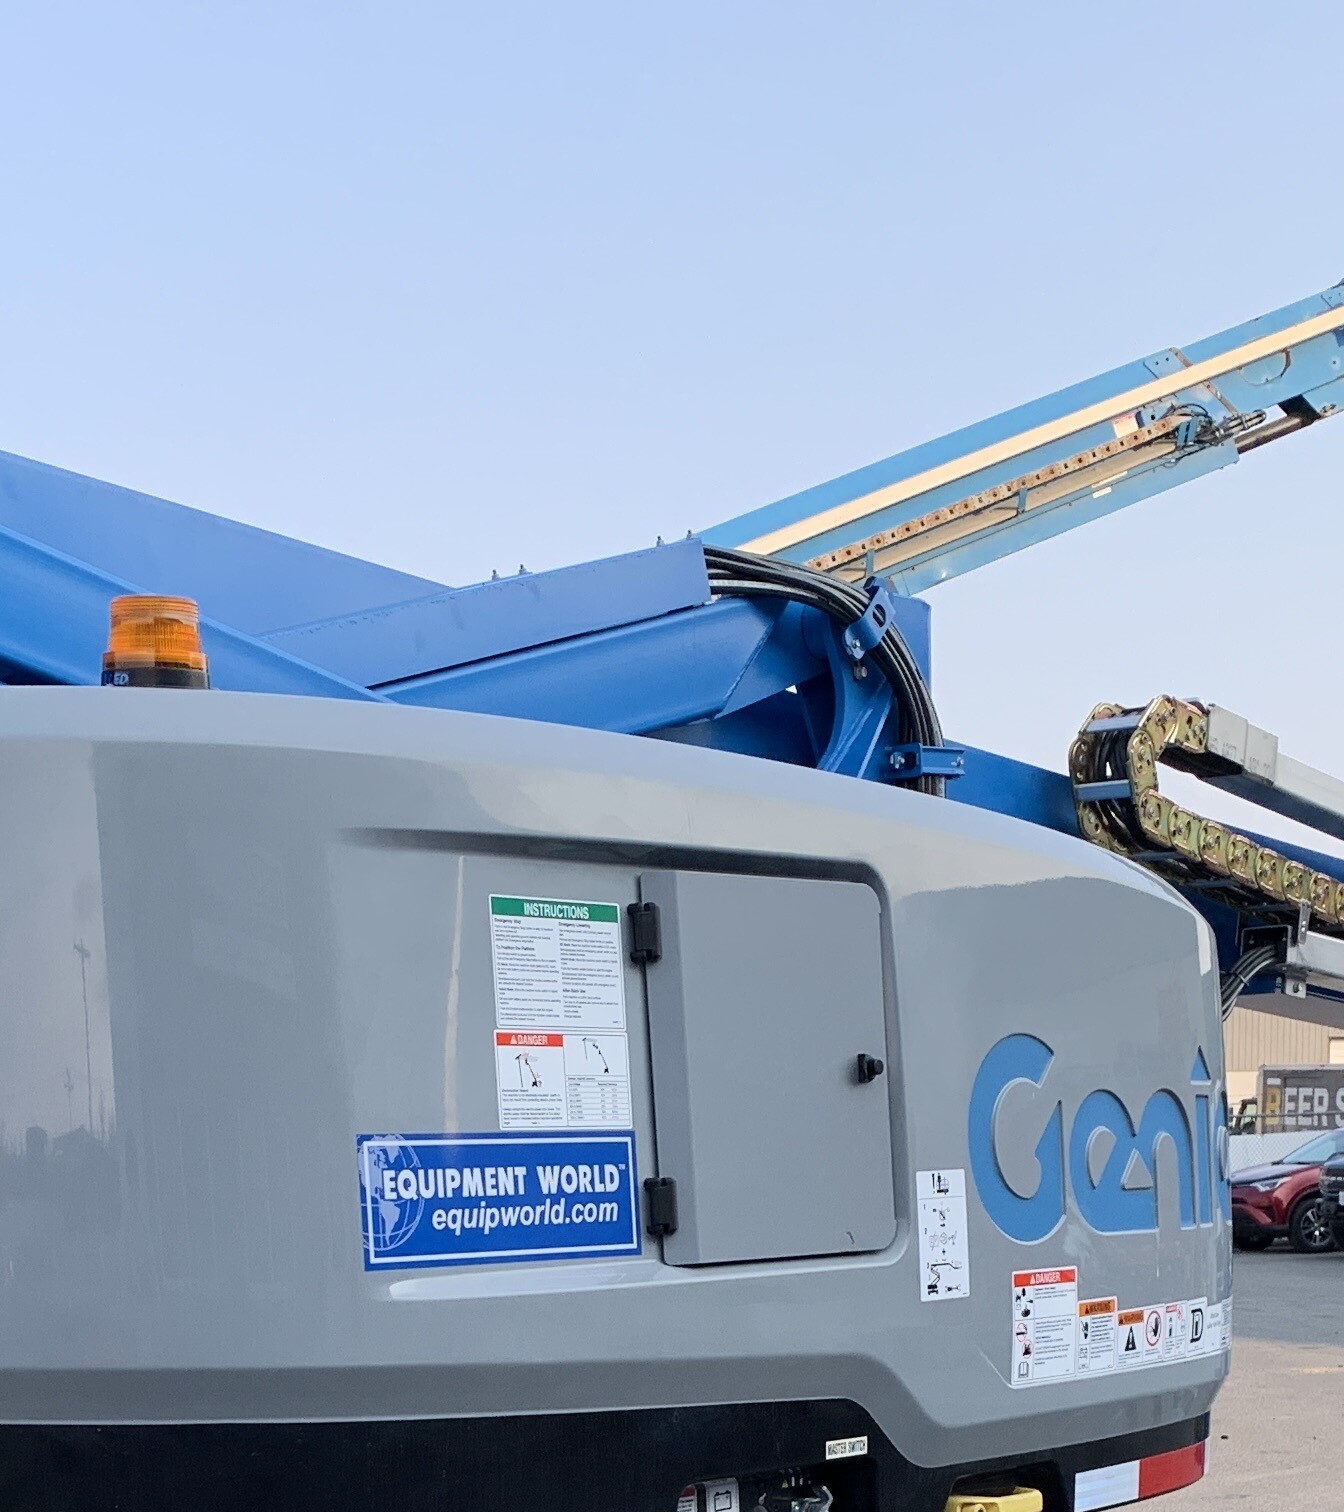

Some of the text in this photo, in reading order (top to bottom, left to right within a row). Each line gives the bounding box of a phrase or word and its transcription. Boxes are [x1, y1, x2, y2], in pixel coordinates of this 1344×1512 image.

[523, 902, 589, 919] INSTRUCTIONS
[517, 1035, 548, 1045] DANGER
[1265, 1087, 1329, 1127] BEER
[382, 1166, 527, 1200] EQUIPMENT
[432, 1198, 618, 1236] equipworld.com
[1035, 1271, 1061, 1284] DANGER
